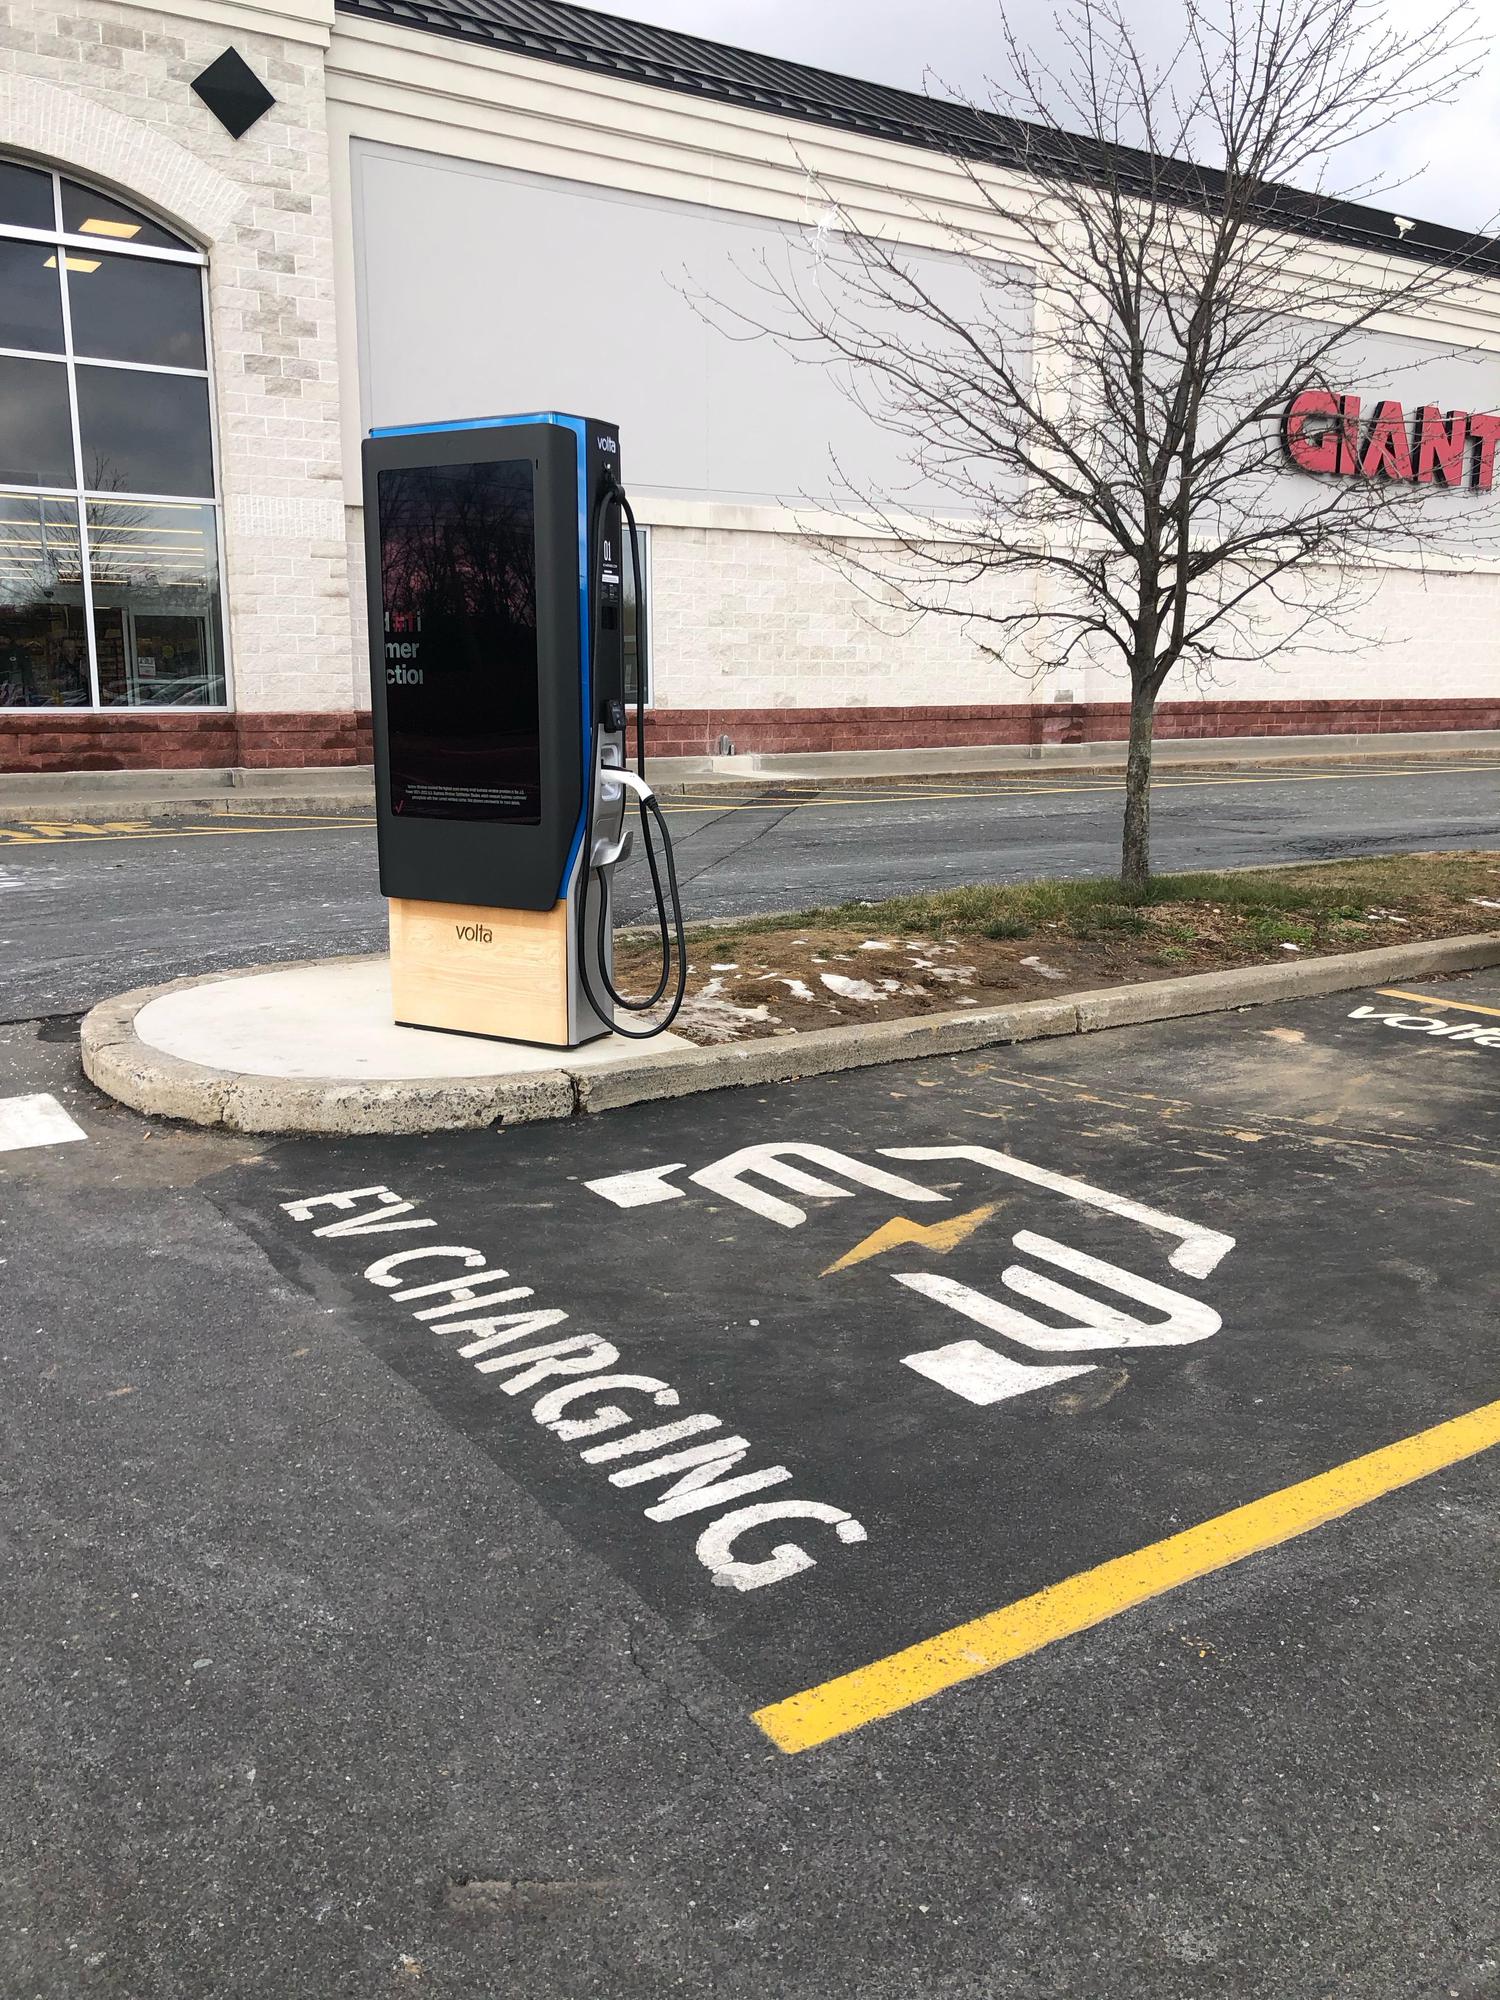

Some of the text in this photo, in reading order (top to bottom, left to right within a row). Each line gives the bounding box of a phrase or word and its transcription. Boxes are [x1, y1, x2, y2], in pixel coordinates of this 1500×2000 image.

[597, 436, 616, 453] volta
[1281, 390, 1500, 491] GIANT
[603, 540, 612, 561] 01
[456, 923, 492, 943] volta
[279, 1185, 867, 1591] EV CHARGING
